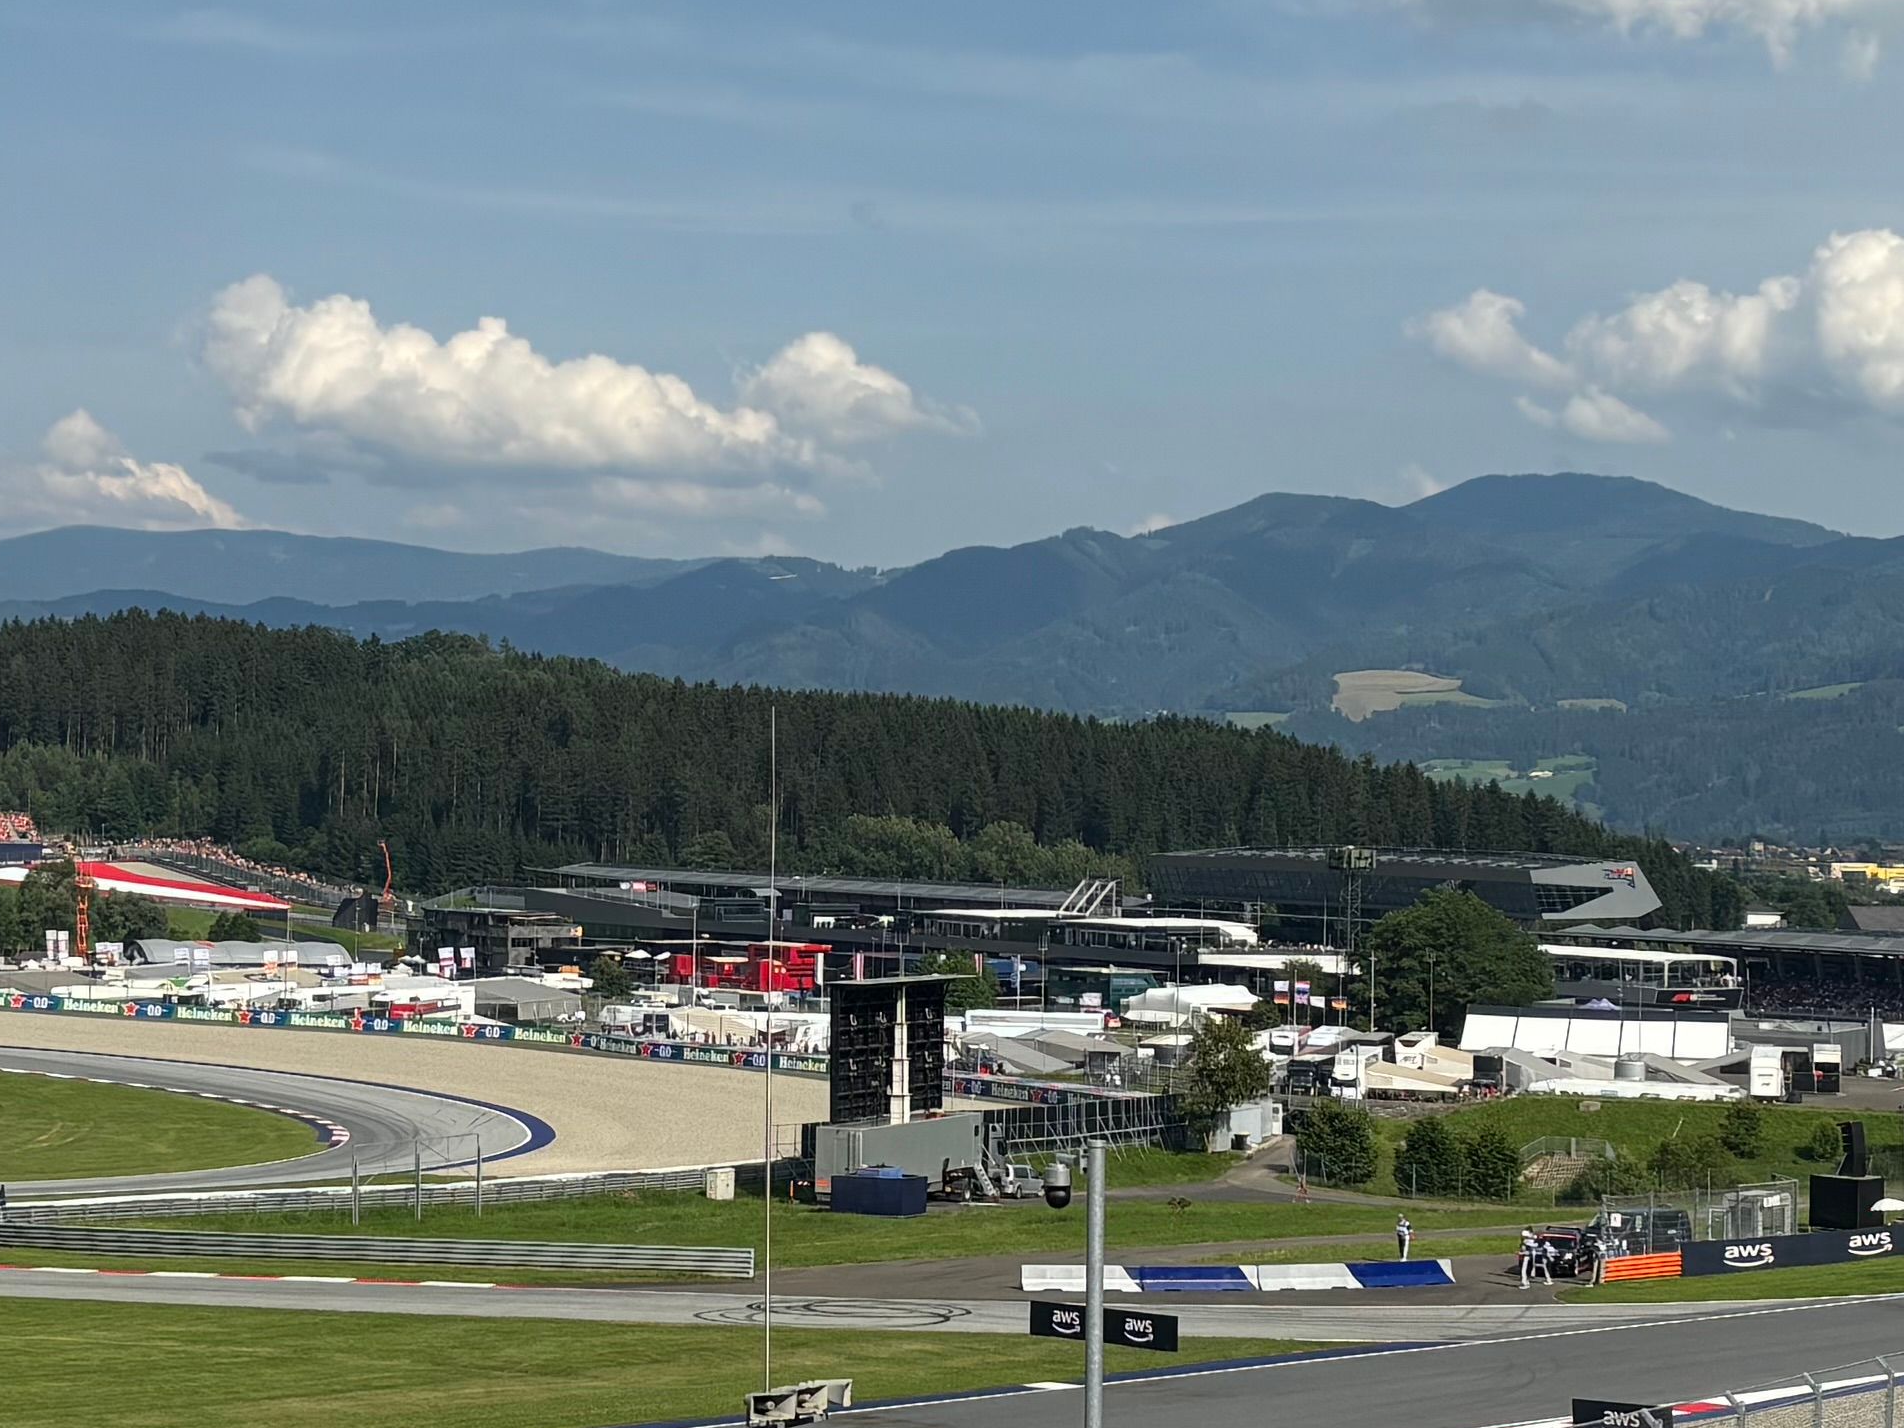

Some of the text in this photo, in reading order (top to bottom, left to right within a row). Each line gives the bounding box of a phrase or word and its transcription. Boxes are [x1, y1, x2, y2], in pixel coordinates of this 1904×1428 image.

[63, 999, 120, 1013] Heineken
[177, 1006, 234, 1021] Heineken
[290, 1014, 347, 1029] Heineken
[403, 1021, 459, 1036] Heineken
[515, 1027, 566, 1043] Heineken
[683, 1047, 729, 1063] Heineken
[779, 1056, 828, 1073] Heineken
[1723, 1243, 1773, 1259] aws
[1849, 1231, 1892, 1248] aws
[1051, 1309, 1081, 1326] aws
[1124, 1317, 1153, 1334] aws
[1603, 1410, 1641, 1428] aws
